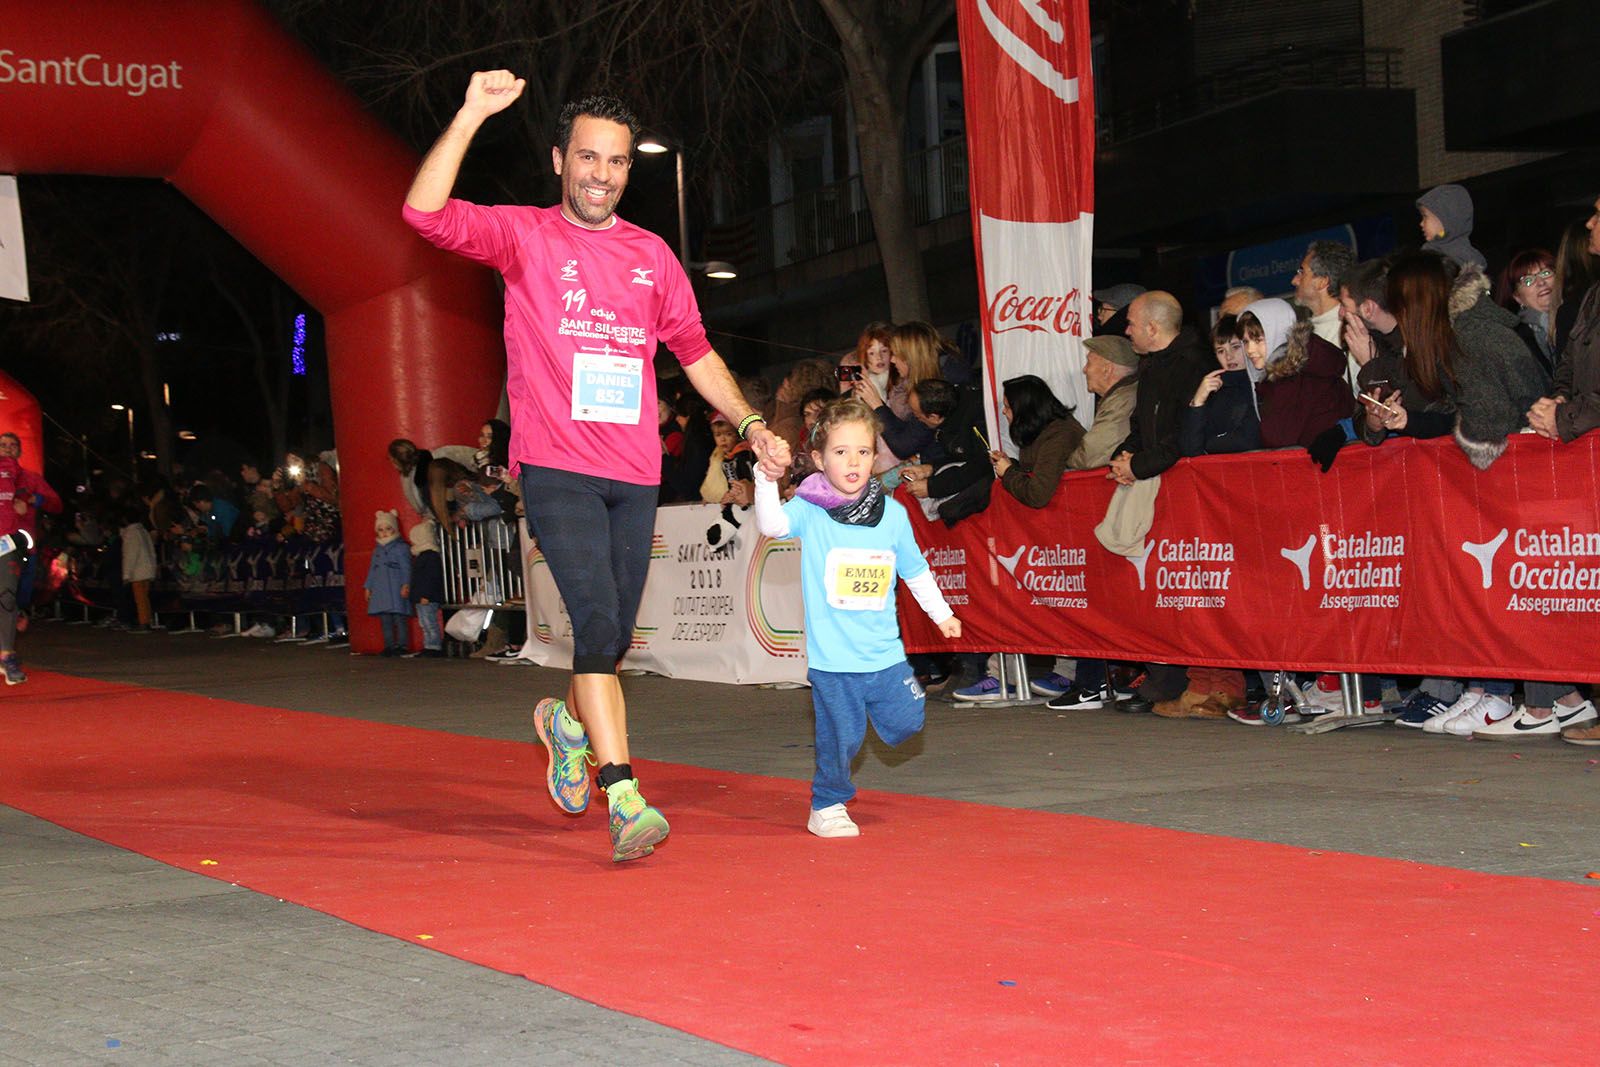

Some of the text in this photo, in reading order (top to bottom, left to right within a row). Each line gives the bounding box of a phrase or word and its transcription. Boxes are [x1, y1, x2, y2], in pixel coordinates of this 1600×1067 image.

[0, 49, 183, 97] SantCugat
[561, 288, 587, 312] 19
[560, 317, 593, 331] SANT
[585, 372, 634, 388] DANIEL
[595, 388, 625, 404] 852
[1027, 543, 1087, 567] Catalana
[1158, 536, 1235, 562] Catalana
[1324, 530, 1405, 560] Catalana
[690, 568, 722, 590] 2018
[845, 567, 886, 579] EMMA
[1023, 569, 1087, 592] Occident
[1156, 564, 1232, 590] Occident
[1323, 561, 1402, 590] Occident
[852, 580, 879, 593] 852
[1155, 593, 1226, 611] Assegurances
[1319, 593, 1400, 613] Assegurances
